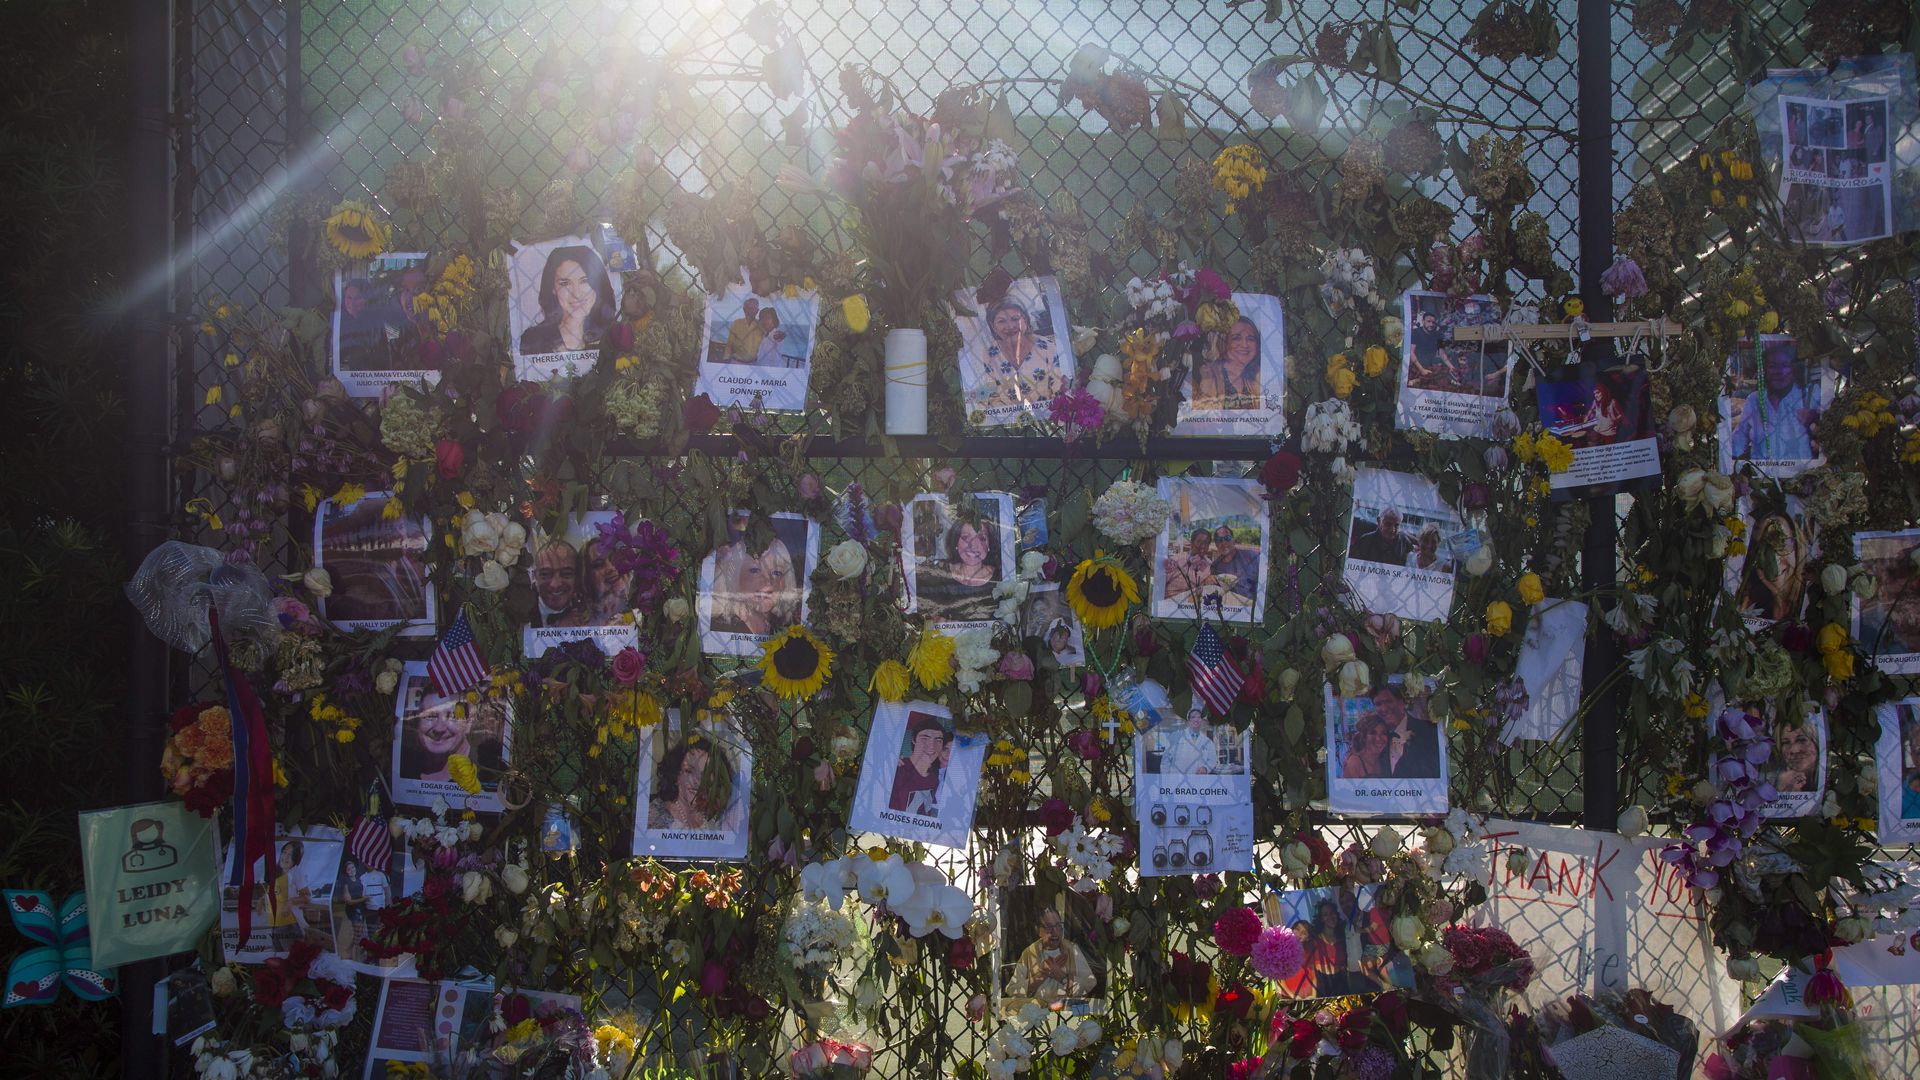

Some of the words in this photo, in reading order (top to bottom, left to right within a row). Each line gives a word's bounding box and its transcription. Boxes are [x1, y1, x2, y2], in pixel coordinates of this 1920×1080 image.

[1830, 177, 1882, 188] ROVIROSA
[532, 356, 566, 364] THERESA
[566, 352, 600, 361] VELASQU
[718, 376, 752, 385] CLAUDIO
[1346, 564, 1366, 573] JUAN
[1368, 567, 1390, 575] MORA
[1410, 574, 1427, 582] ANA
[1428, 577, 1452, 585] MORA
[880, 811, 911, 824] MOISES
[912, 818, 943, 830] RODAN
[1480, 831, 1620, 902] THANK
[117, 878, 187, 903] LEIDY
[122, 904, 190, 929] LUNA
[222, 930, 240, 939] Lad
[224, 942, 265, 952] Paguay
